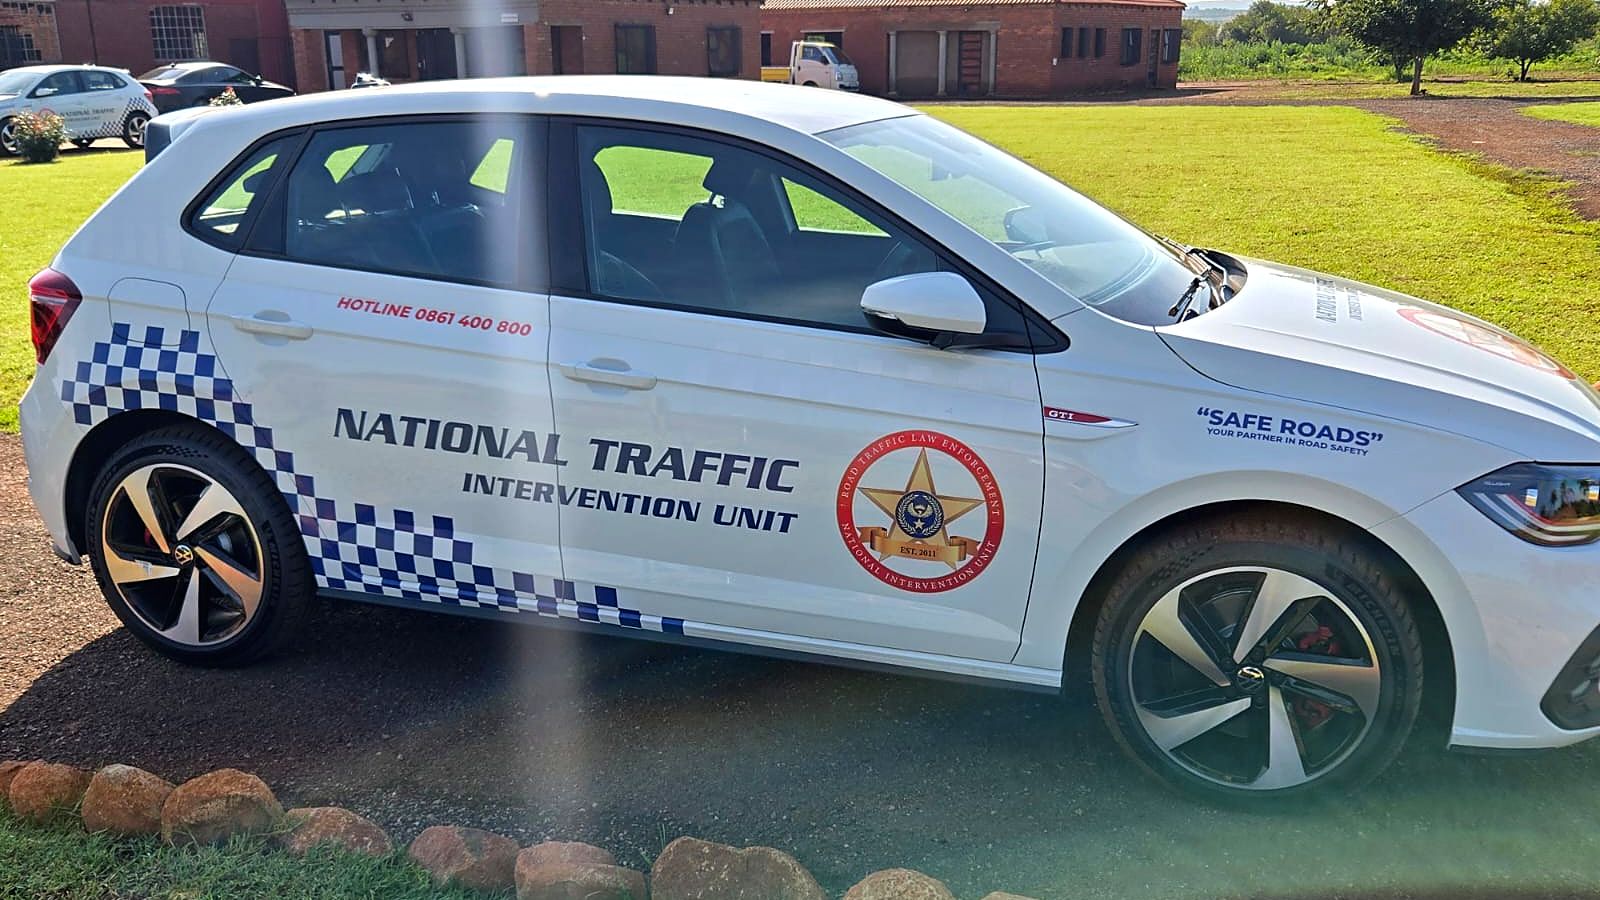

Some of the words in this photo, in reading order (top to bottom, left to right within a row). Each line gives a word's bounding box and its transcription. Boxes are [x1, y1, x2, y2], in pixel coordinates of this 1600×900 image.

[337, 297, 413, 318] HOTLINE
[415, 308, 455, 325] 0861
[458, 315, 493, 331] 400
[497, 321, 532, 337] 800
[1049, 410, 1074, 420] GTI
[333, 407, 569, 467] NATIONAL
[589, 438, 800, 493] TRAFFIC
[1207, 427, 1234, 438] YOUR
[1236, 431, 1283, 443] PARTNER
[1285, 437, 1296, 445] IN
[1298, 439, 1328, 449] ROAD
[1330, 444, 1368, 457] SAFETY
[841, 467, 859, 498] ROAD
[859, 435, 905, 465] TRAFFIC
[911, 433, 937, 443] LAW
[942, 439, 1001, 517] ENFORCEMENT
[462, 472, 702, 522] INTERVENTION
[712, 504, 799, 534] UNIT
[841, 522, 881, 576] NATIONAL
[884, 567, 976, 590] INTERVENTION
[976, 541, 997, 567] UNIT
[900, 546, 918, 556] EST.
[919, 549, 937, 558] 2011
